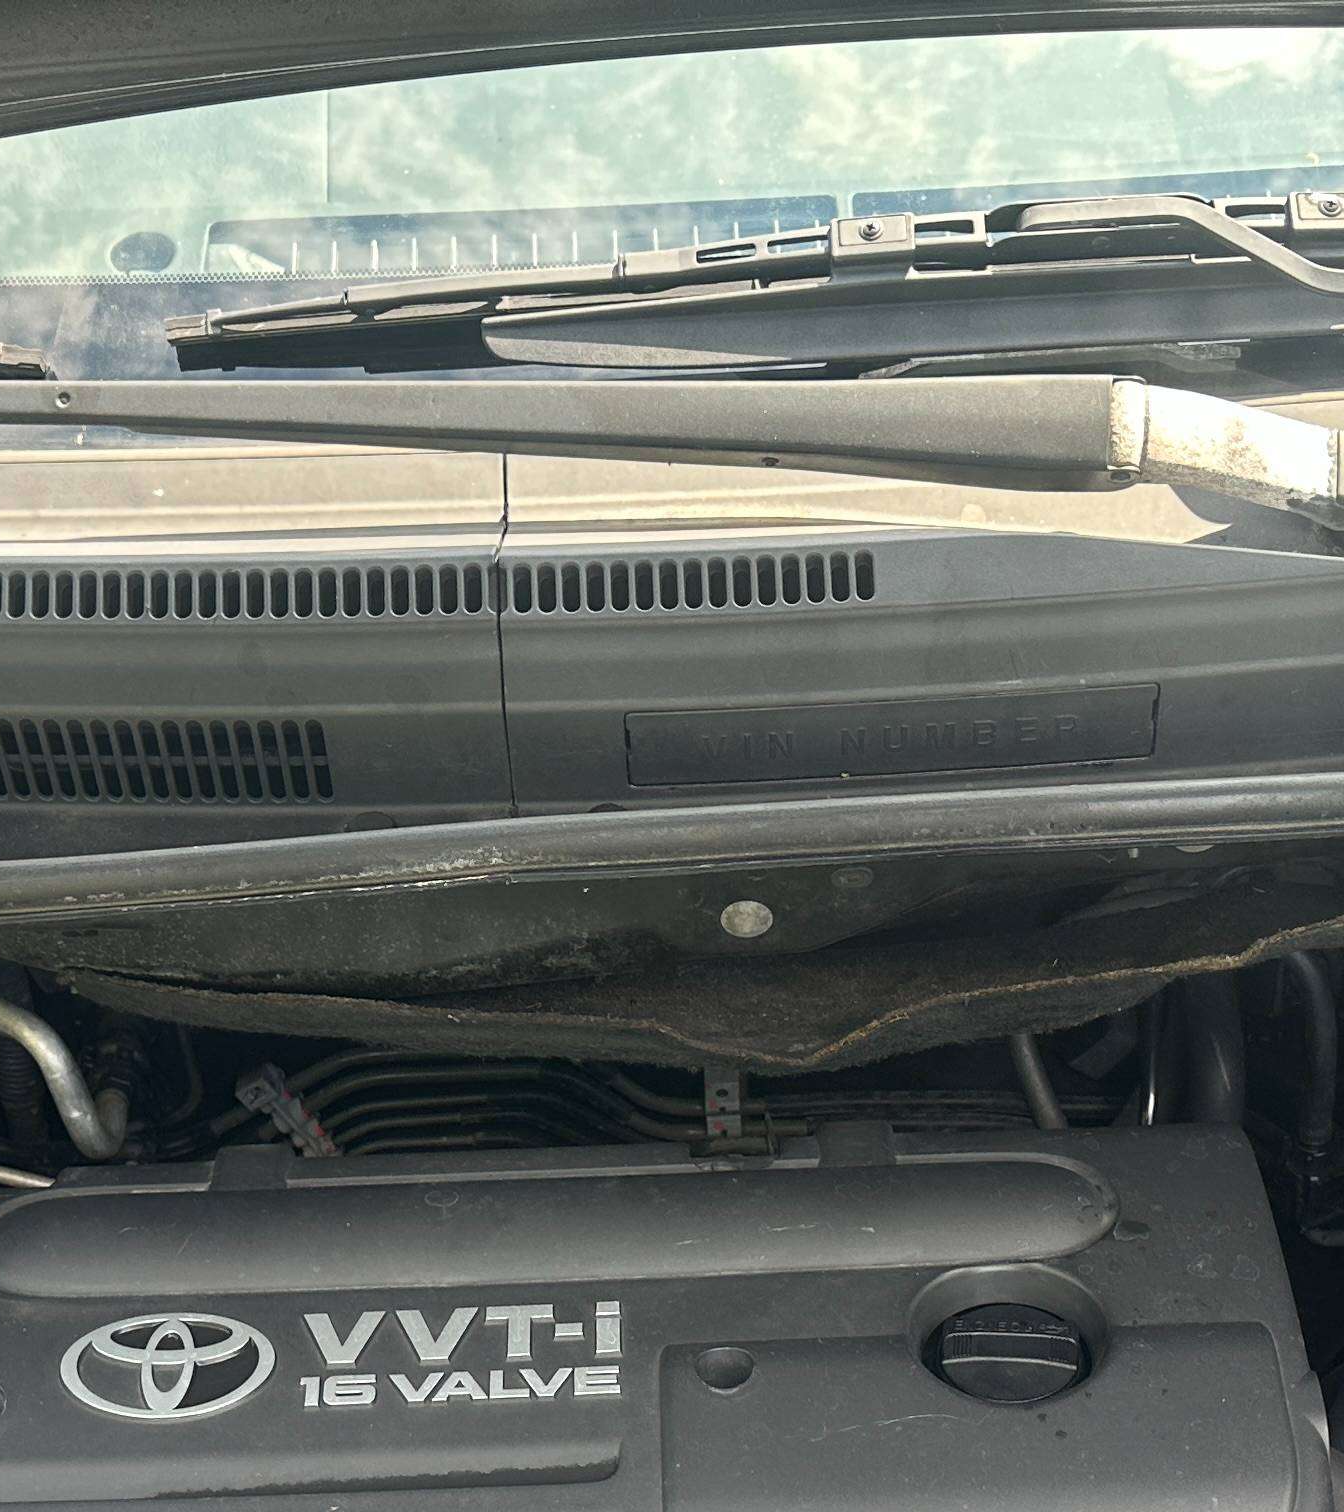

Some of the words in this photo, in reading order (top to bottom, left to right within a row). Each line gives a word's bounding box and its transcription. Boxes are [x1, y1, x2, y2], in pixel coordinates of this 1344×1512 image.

[701, 730, 794, 761] VIN
[299, 1373, 378, 1409] 16
[387, 1365, 622, 1405] VALVE
